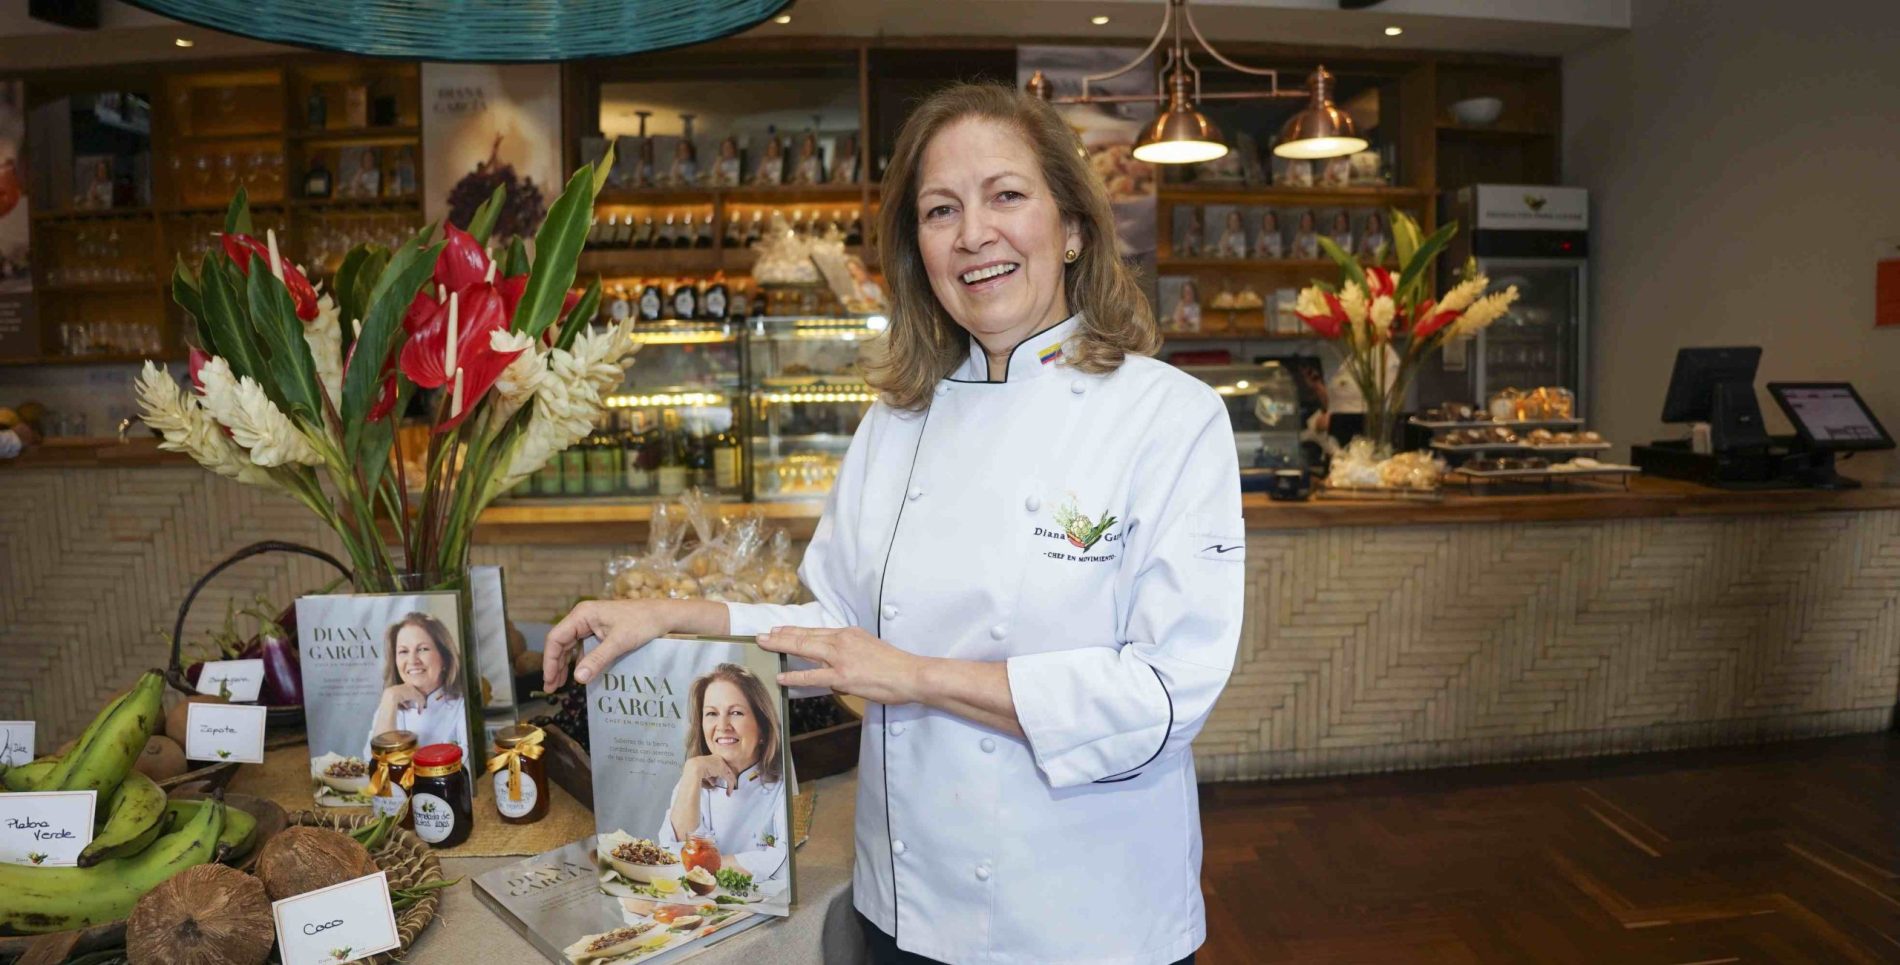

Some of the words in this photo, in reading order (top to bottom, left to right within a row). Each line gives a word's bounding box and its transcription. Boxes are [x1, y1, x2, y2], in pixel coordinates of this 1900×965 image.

[1034, 527, 1066, 541] Diana
[1067, 554, 1076, 562] EN
[313, 627, 372, 641] DIANA
[309, 641, 378, 659] GARCÍA
[603, 673, 672, 695] DIANA
[598, 695, 681, 719] GARCÍA
[34, 828, 76, 841] Verde
[507, 861, 577, 888] DIANA
[303, 919, 344, 936] Coco
